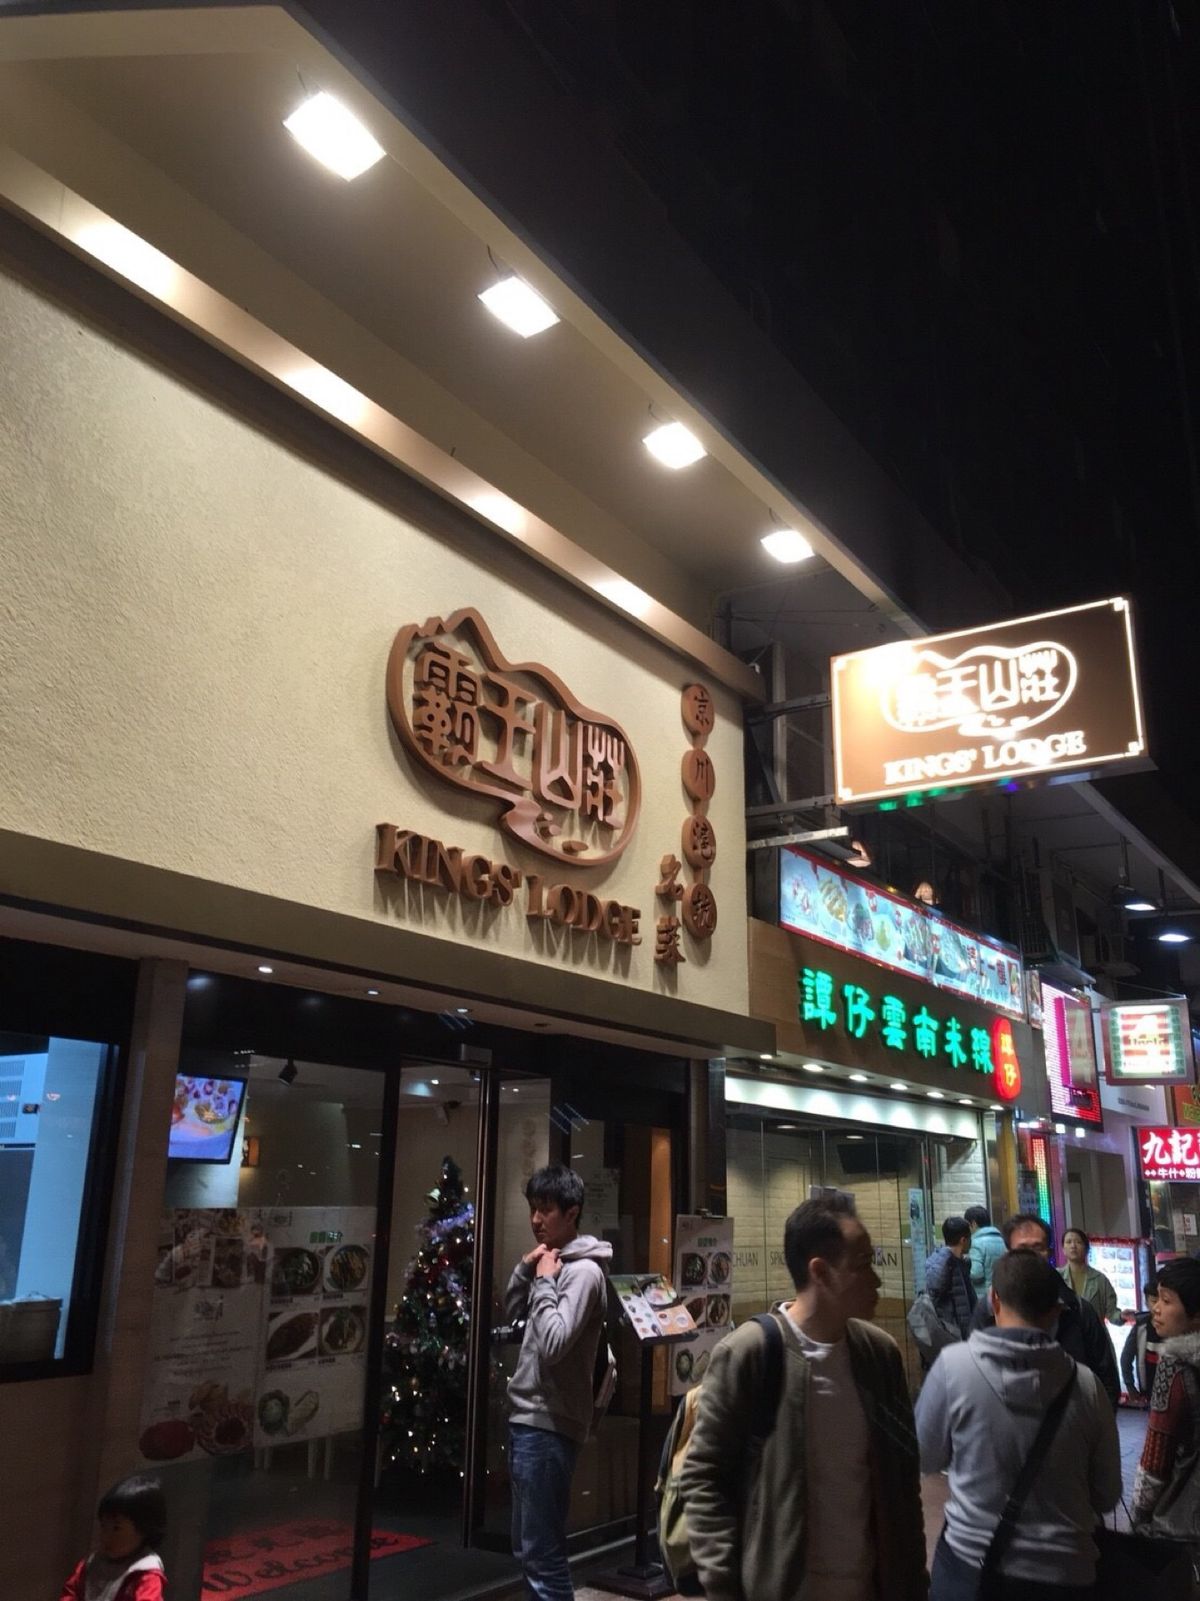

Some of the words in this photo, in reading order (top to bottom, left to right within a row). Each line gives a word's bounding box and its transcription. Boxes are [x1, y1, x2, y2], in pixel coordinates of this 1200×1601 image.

[982, 730, 1087, 770] LODGE
[526, 874, 643, 945] LODGE
[803, 968, 995, 1074] 譚仔雲南米線
[1142, 1129, 1200, 1166] 九記
